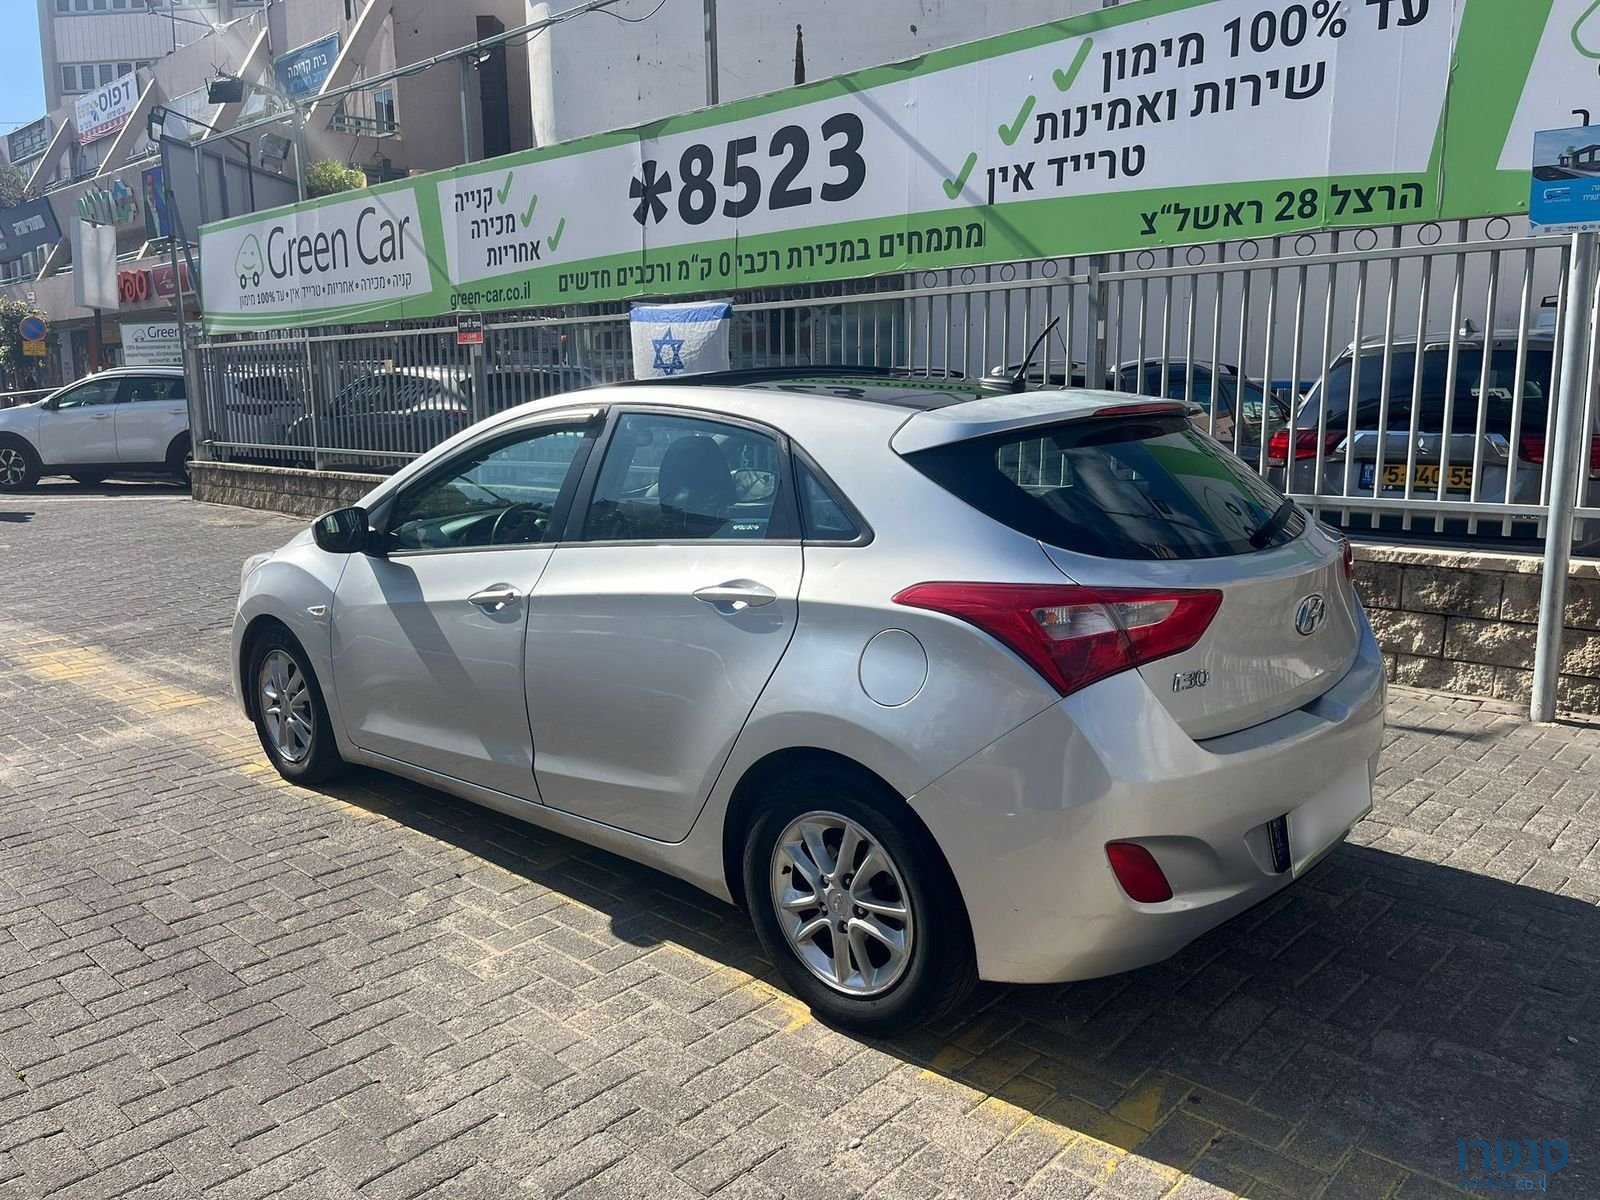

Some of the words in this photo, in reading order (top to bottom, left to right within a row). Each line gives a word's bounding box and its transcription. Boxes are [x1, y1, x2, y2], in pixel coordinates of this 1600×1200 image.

[1366, 0, 1429, 30] עד
[1223, 0, 1347, 58] 100%
[1102, 32, 1205, 93] מימון
[98, 80, 130, 113] דפוס
[1190, 61, 1326, 117] שירות
[1034, 88, 1177, 144] ואמינות
[1047, 144, 1145, 187] טרייד
[987, 161, 1035, 205] אין
[455, 187, 492, 213] קנייה
[1275, 188, 1318, 222] 28
[1331, 183, 1424, 216] הרצל
[471, 213, 516, 239] מכירה
[267, 226, 349, 279] Green
[356, 207, 410, 265] Car
[486, 240, 541, 267] אחריות
[786, 238, 870, 270] במכירת
[880, 222, 983, 259] מתמחים
[617, 262, 671, 287] ורכבים
[719, 251, 731, 277] 0
[736, 250, 780, 275] רכבי
[301, 284, 321, 298] טרייד
[327, 279, 354, 296] אחריות
[361, 276, 386, 291] מכירה
[392, 272, 412, 290] קניה
[558, 269, 611, 292] חדשים
[257, 291, 276, 304] 100%
[276, 290, 285, 302] עד
[290, 288, 300, 304] אין
[450, 280, 531, 311] green-car.co.il
[1172, 668, 1209, 692] i30
